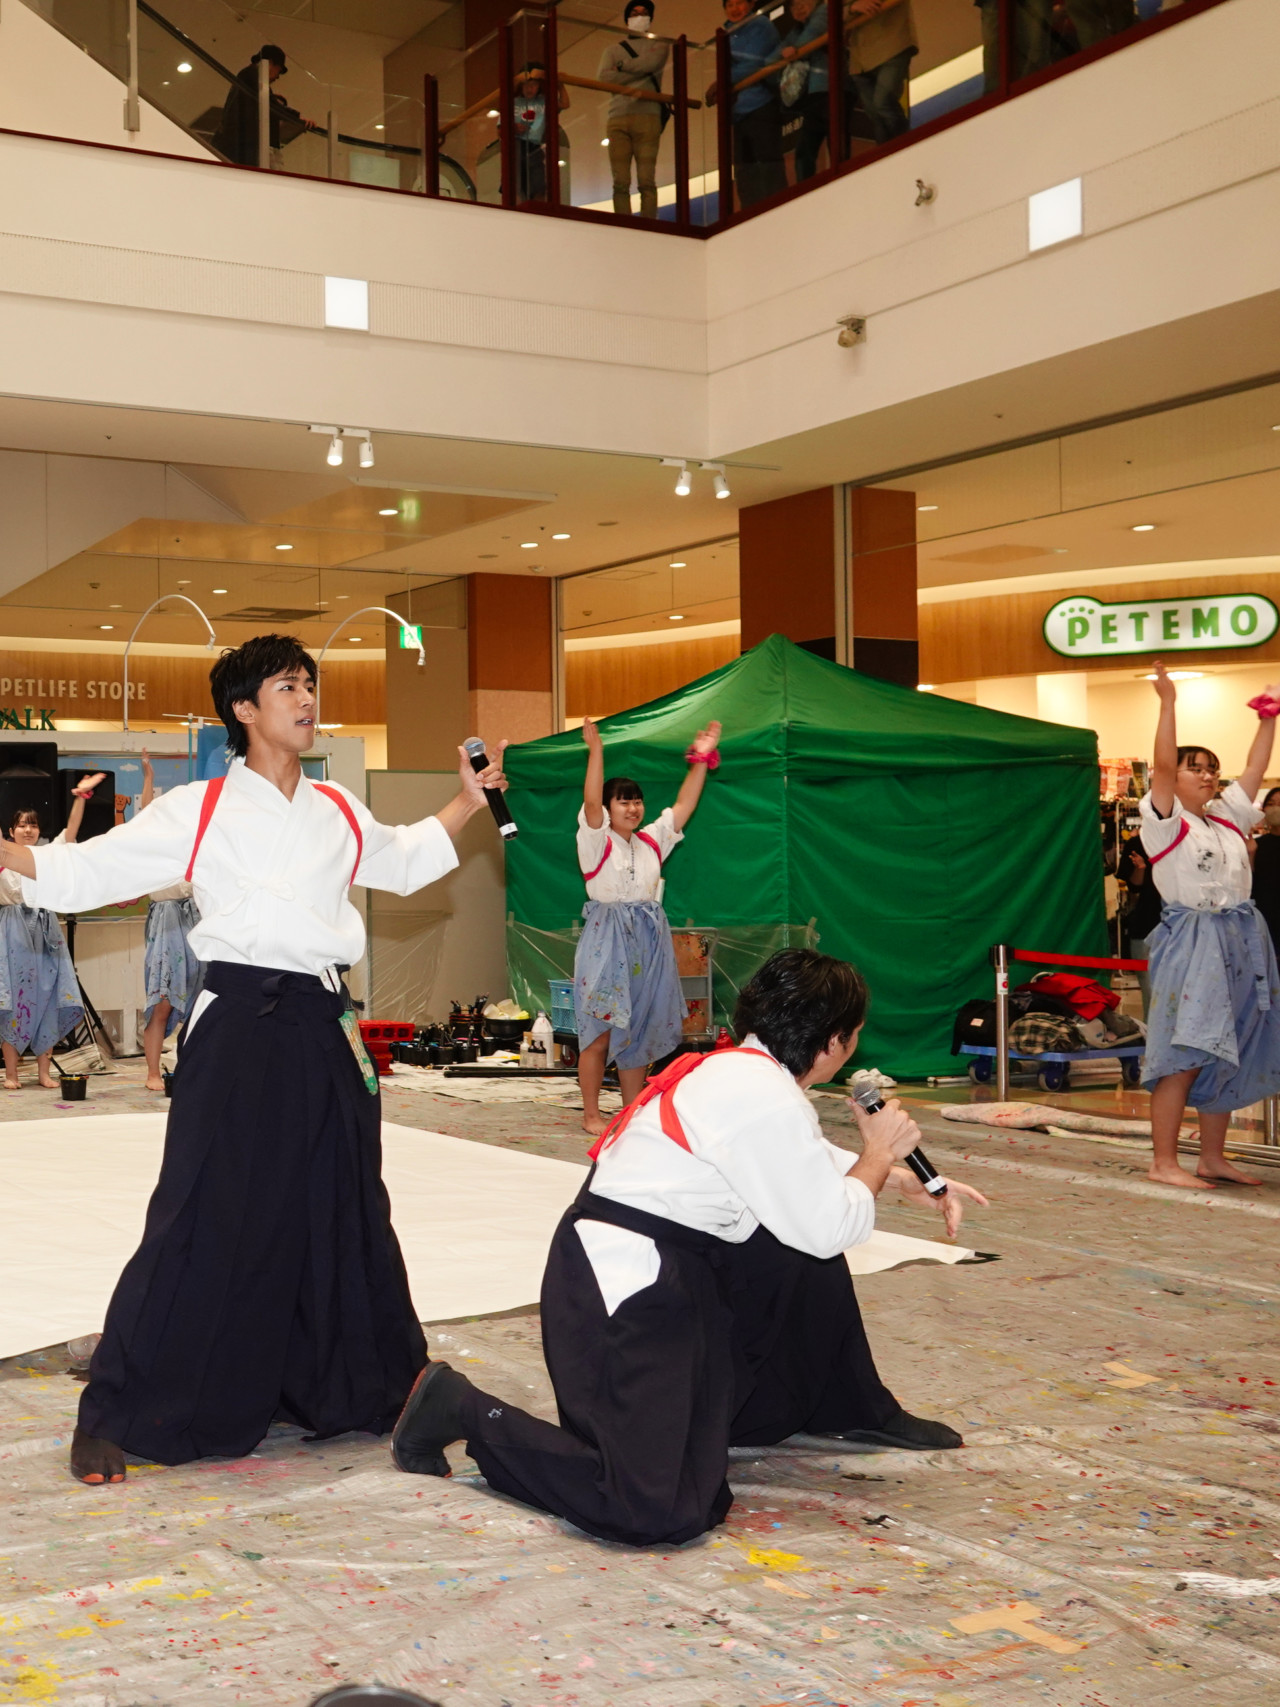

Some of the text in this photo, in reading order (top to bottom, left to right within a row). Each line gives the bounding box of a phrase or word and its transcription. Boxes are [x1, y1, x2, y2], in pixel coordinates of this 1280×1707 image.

[1067, 604, 1259, 647] PETEMO
[0, 677, 78, 699] PETLIFE
[86, 680, 147, 700] STORE
